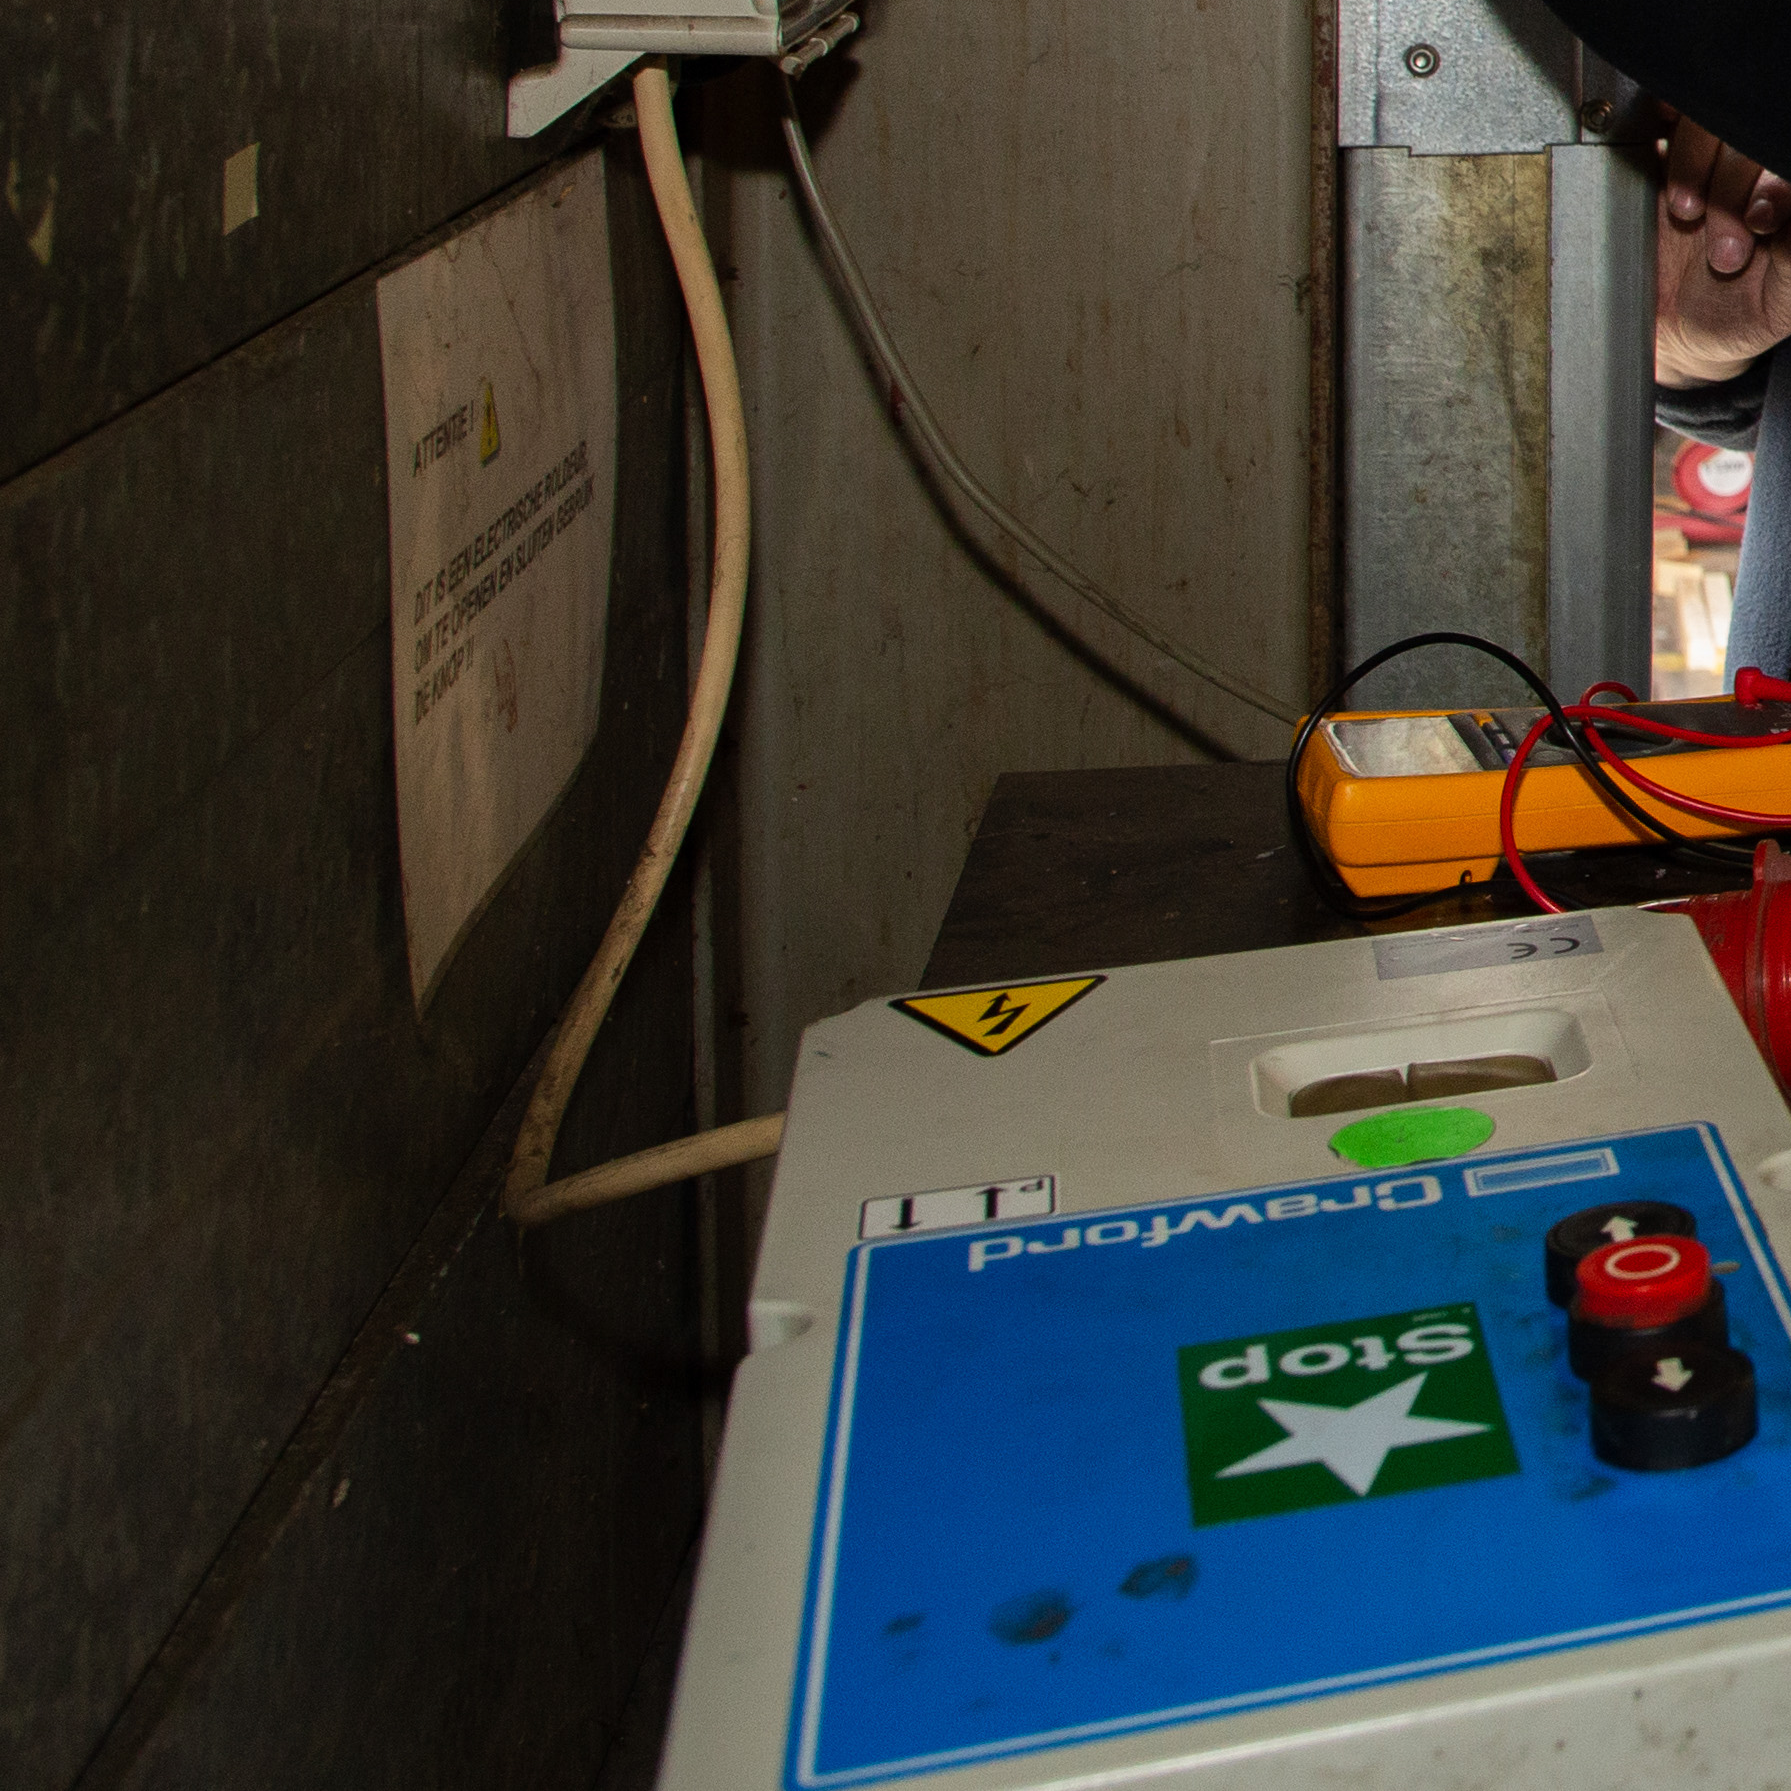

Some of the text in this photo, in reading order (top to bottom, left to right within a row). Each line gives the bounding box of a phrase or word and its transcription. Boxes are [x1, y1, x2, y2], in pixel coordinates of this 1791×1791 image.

[412, 404, 468, 478] ATTENTIE
[414, 579, 434, 626] DIT
[434, 568, 446, 606] IS
[449, 545, 472, 593] EEN
[414, 630, 434, 674] OM
[434, 614, 449, 654] TE
[451, 567, 498, 636] OPENEN
[497, 554, 515, 593] EN
[515, 515, 555, 576] SLUITEN
[414, 677, 431, 725] DE
[431, 645, 464, 706] KNOP
[1507, 937, 1580, 959] CE
[967, 1175, 1443, 1272] Crawford
[1199, 1322, 1476, 1390] Stop
